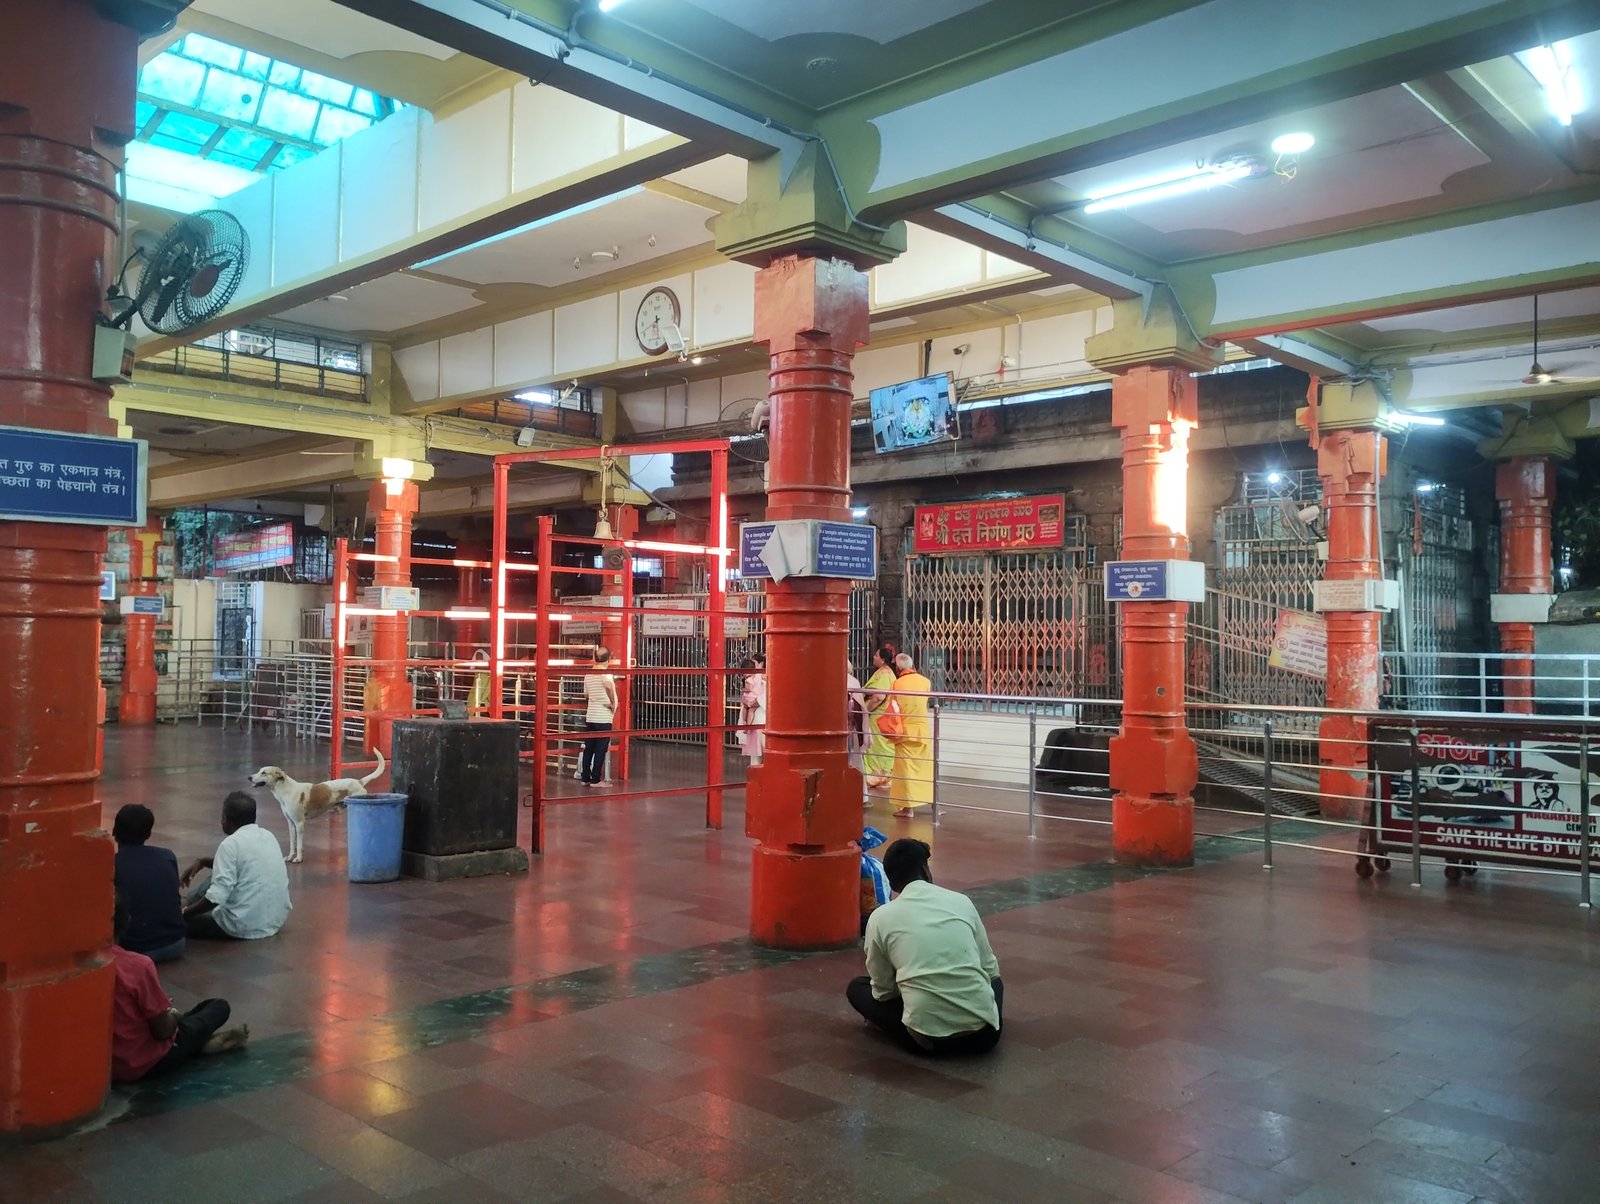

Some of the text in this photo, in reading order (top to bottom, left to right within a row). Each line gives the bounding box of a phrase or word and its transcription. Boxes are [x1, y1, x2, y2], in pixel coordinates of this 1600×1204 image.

[14, 460, 34, 474] गुरु
[39, 462, 55, 473] का
[60, 464, 99, 477] एकमात्र
[0, 475, 31, 488] च्छता
[36, 478, 51, 489] का
[936, 524, 949, 545] श्री
[952, 527, 972, 546] दत्त
[1417, 733, 1487, 761] STOP
[1566, 823, 1597, 834] CEMNT
[1436, 826, 1472, 845] SAVE
[1474, 830, 1503, 849] THE
[1507, 833, 1539, 852] LIFE
[1543, 835, 1562, 854] BY
